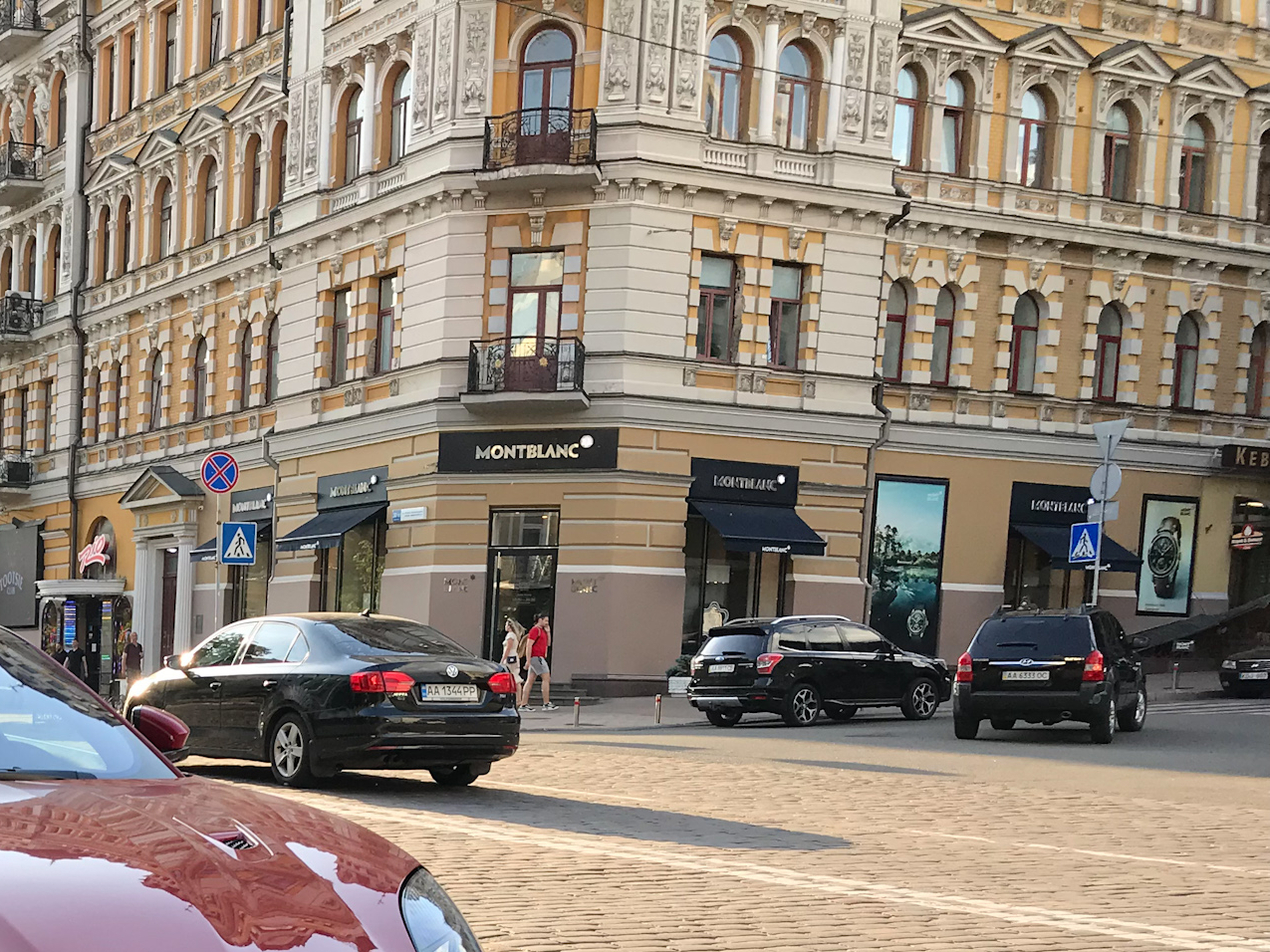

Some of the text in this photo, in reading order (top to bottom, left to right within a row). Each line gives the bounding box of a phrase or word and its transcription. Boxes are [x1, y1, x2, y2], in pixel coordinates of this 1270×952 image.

[475, 443, 580, 460] MONTBLANC
[713, 475, 778, 492] MONTBLANC
[427, 685, 476, 696] AA 1344 PP
